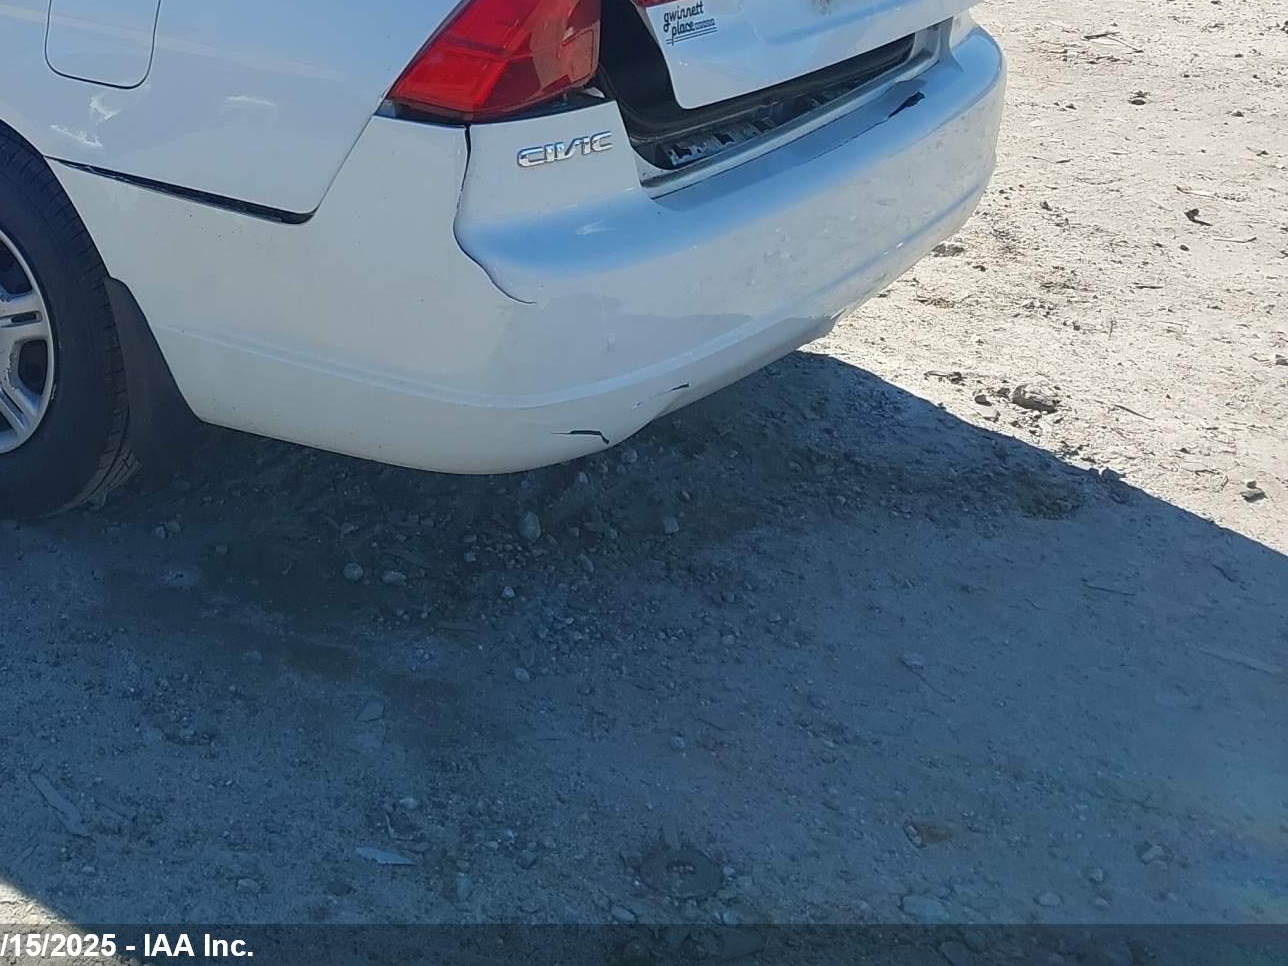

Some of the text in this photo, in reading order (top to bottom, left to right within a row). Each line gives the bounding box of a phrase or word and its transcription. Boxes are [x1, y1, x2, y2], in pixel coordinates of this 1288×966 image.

[663, 0, 704, 32] gwinnett
[672, 20, 695, 46] place
[517, 131, 613, 167] CIVIC
